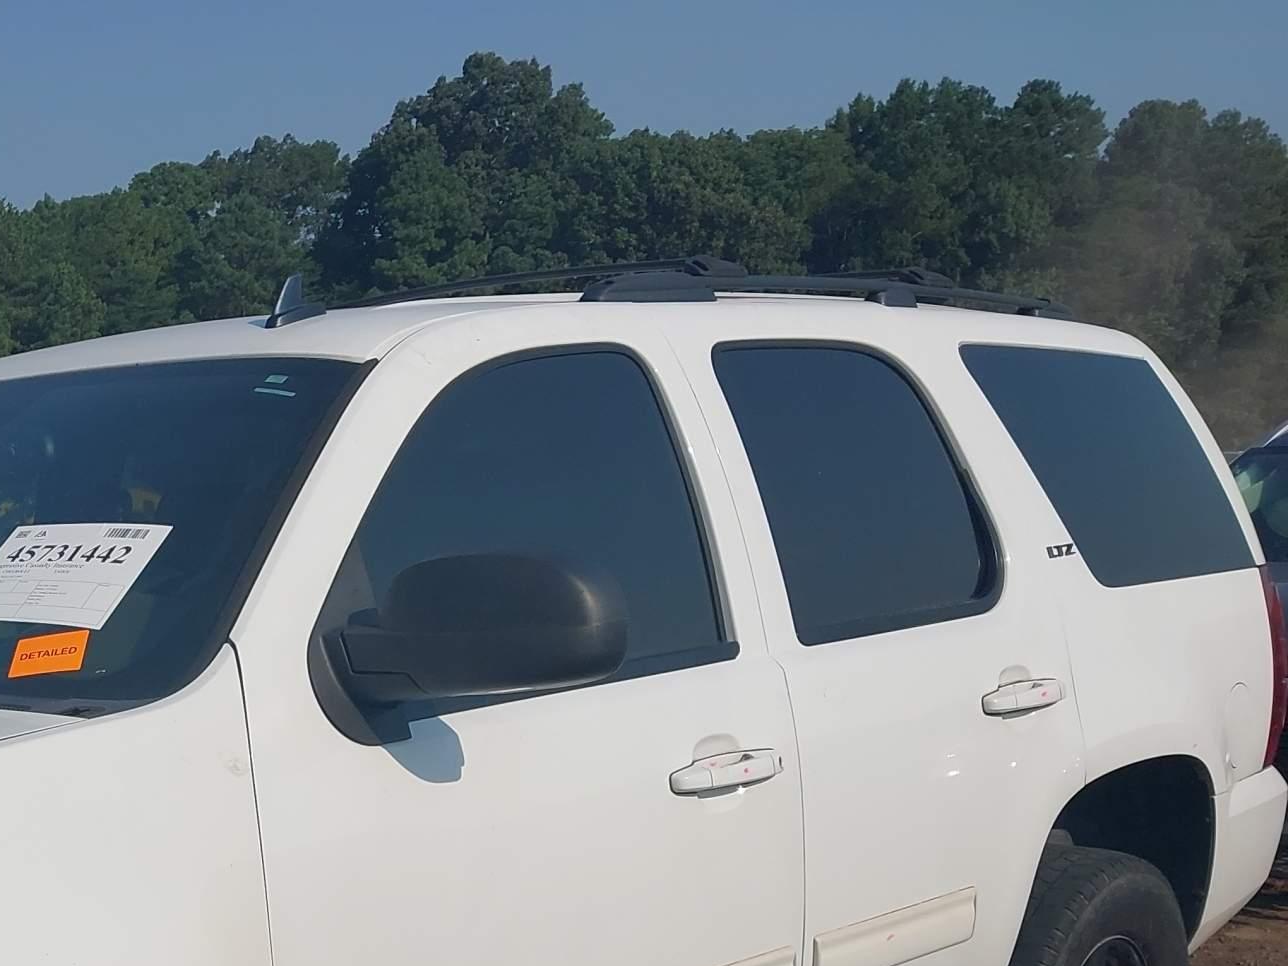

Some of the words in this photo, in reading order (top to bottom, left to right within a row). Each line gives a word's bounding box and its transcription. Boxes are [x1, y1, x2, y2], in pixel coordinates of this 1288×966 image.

[6, 544, 132, 564] 45731442
[1046, 543, 1077, 559] LTZ
[19, 646, 78, 661] DETAILED
